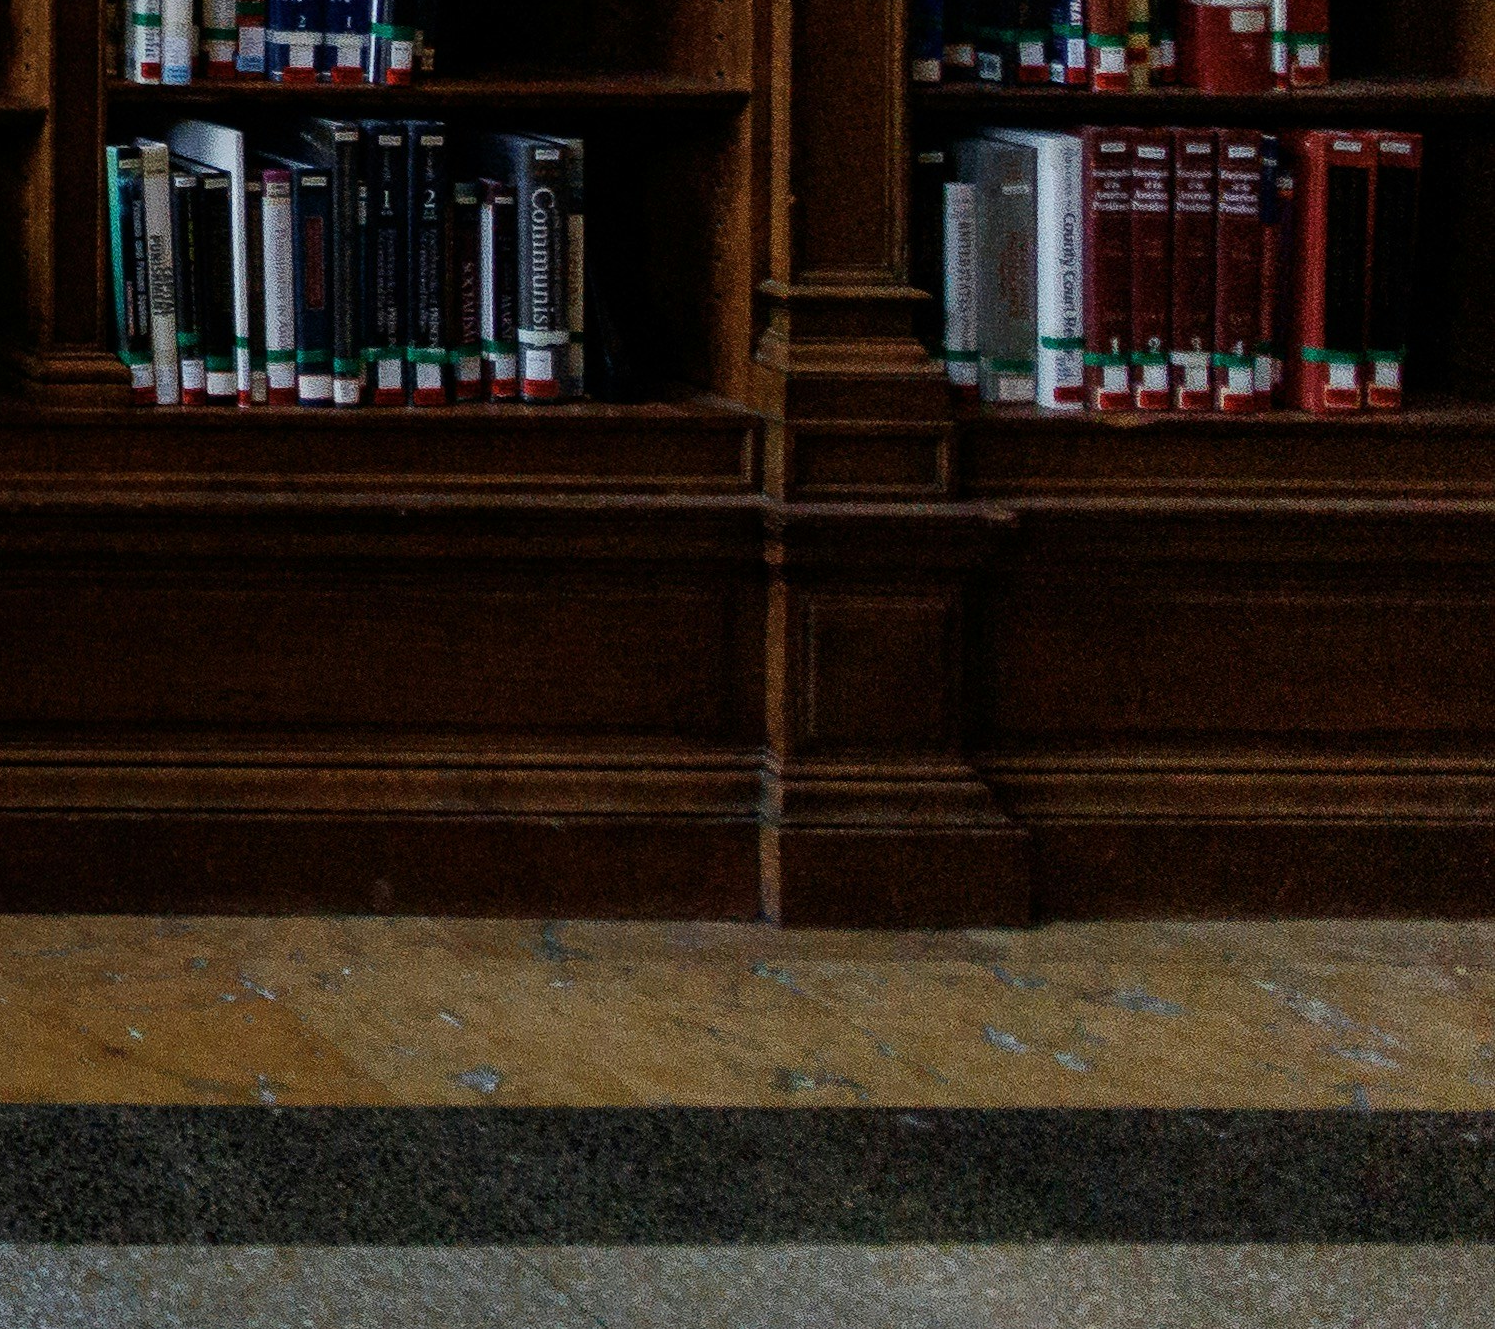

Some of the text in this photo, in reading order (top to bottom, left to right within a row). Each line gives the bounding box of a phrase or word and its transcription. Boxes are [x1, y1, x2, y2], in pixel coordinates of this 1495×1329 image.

[423, 189, 436, 209] 2
[530, 187, 557, 349] Communis
[1059, 213, 1078, 312] County Court
